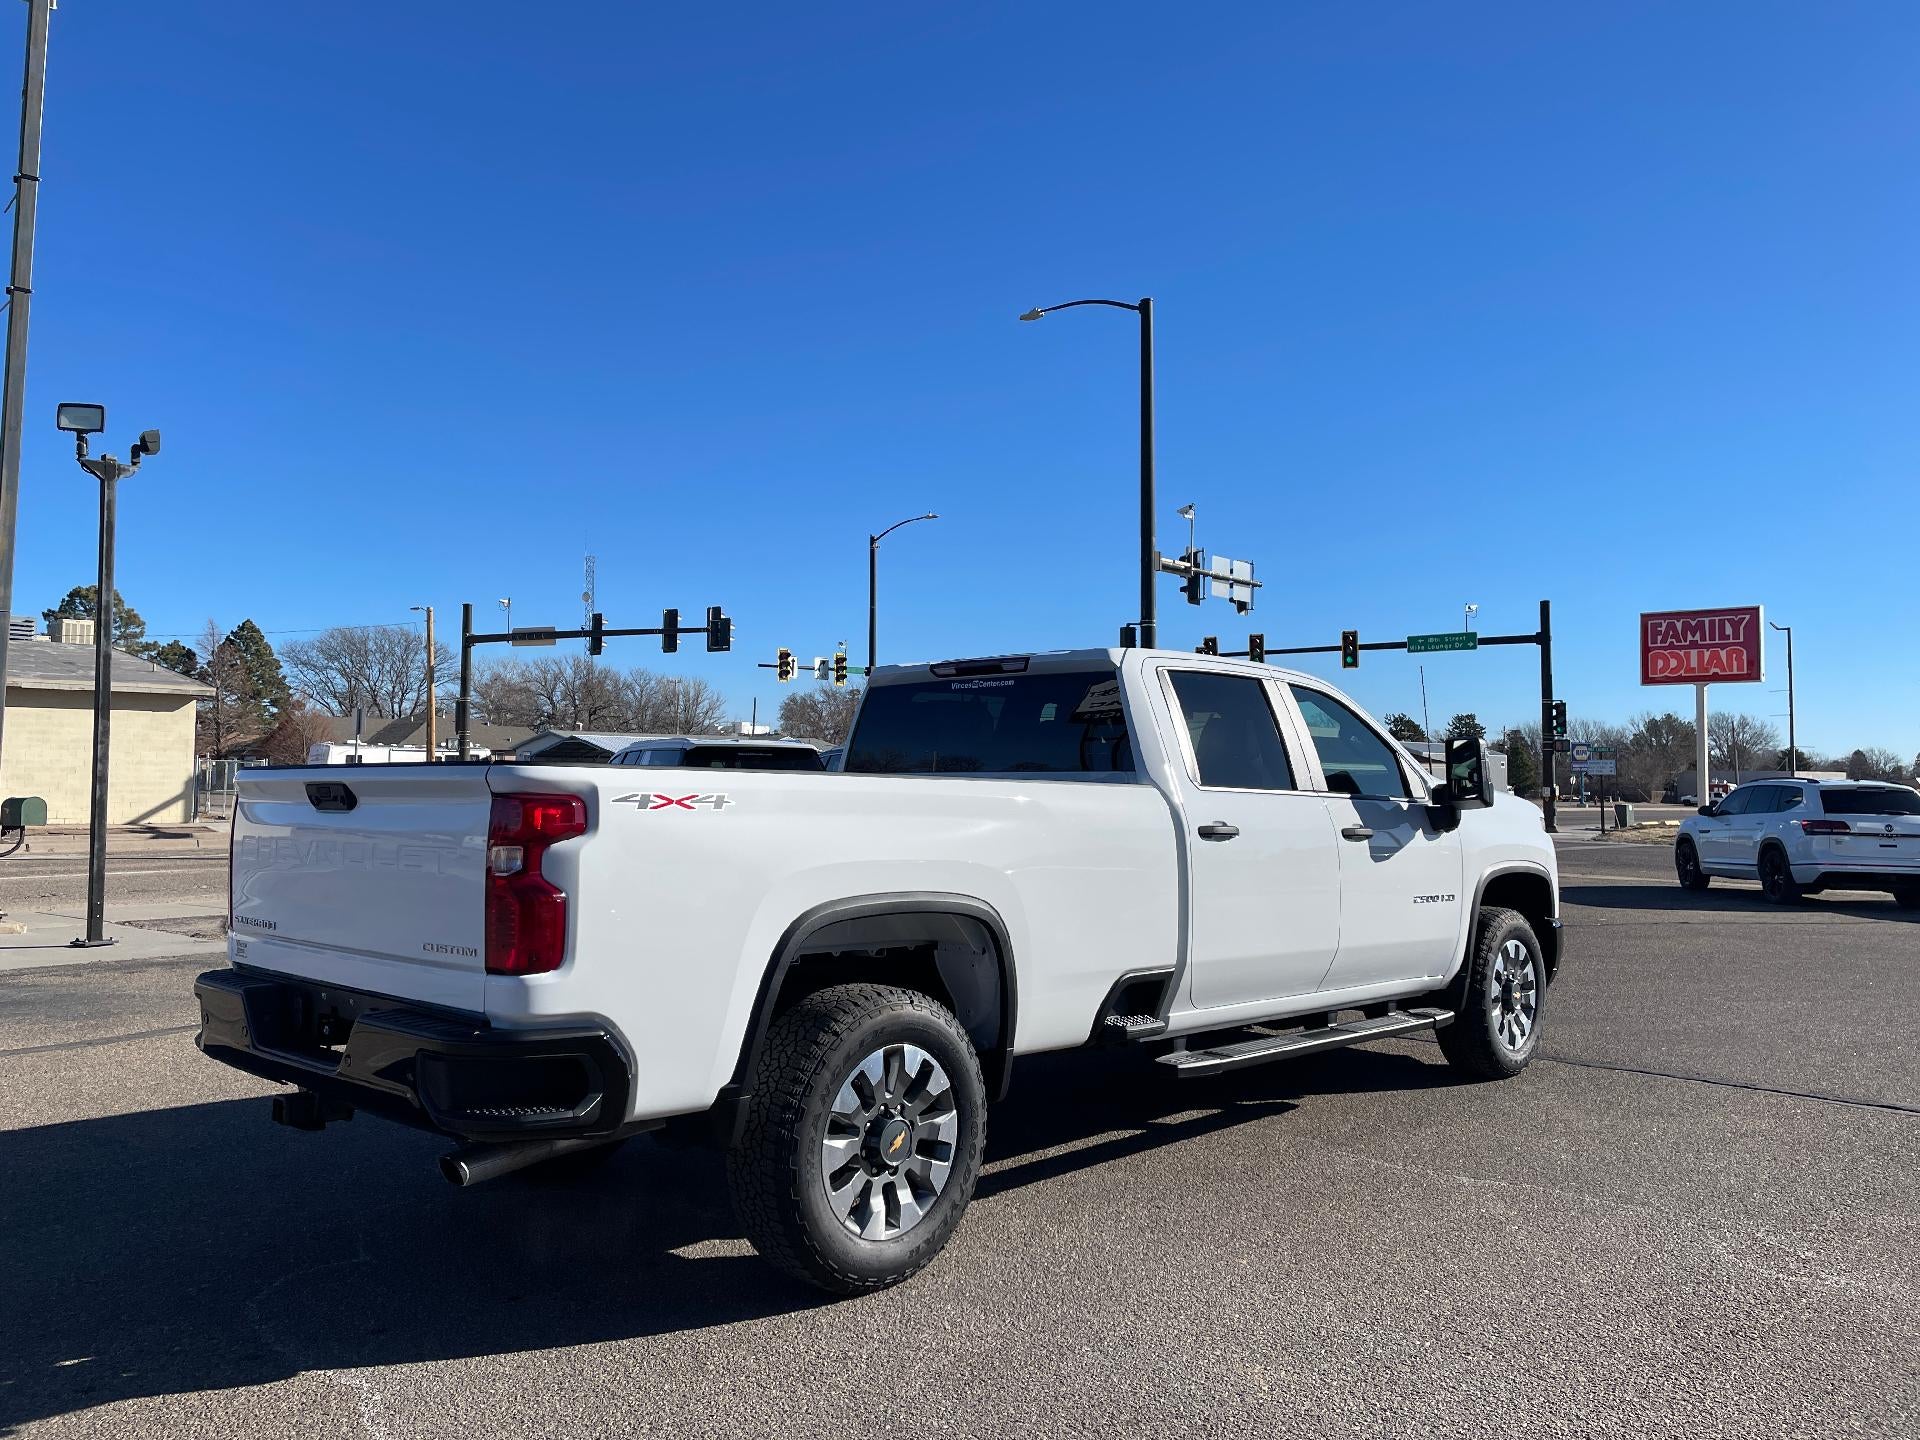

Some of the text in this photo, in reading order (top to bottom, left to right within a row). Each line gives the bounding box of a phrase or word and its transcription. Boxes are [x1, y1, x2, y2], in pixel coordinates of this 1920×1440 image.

[1648, 615, 1750, 647] FAMILY
[1648, 646, 1747, 678] DOLLAR
[234, 915, 277, 931] SILVERADO
[422, 943, 477, 958] CUSTOM
